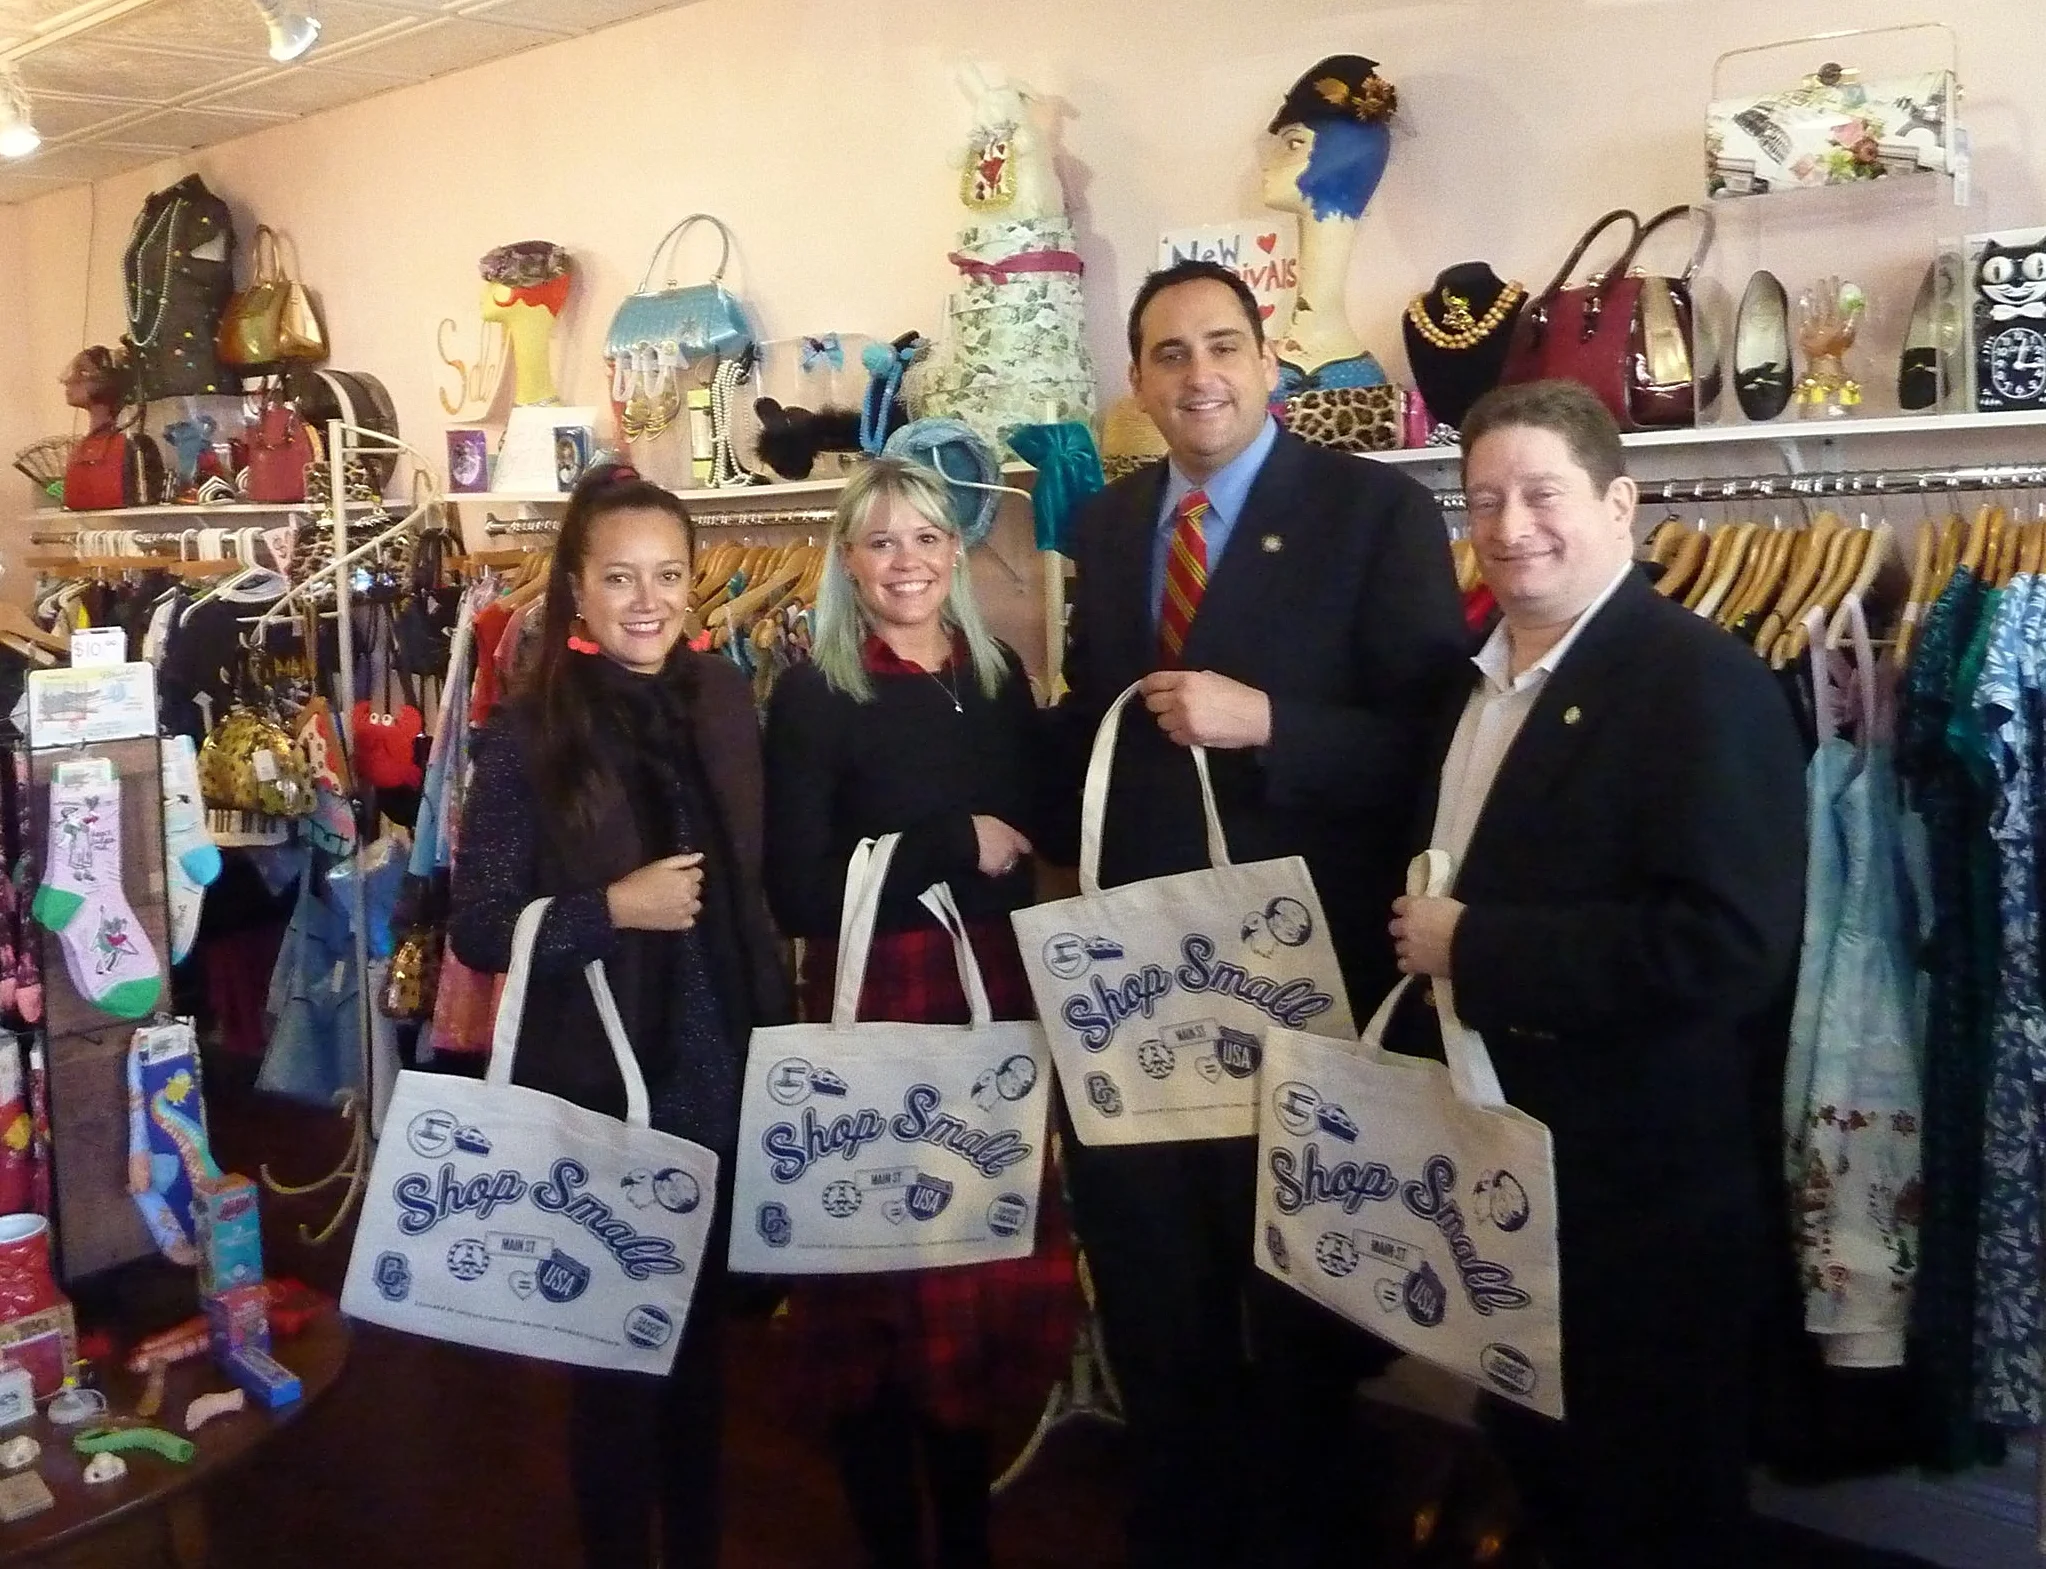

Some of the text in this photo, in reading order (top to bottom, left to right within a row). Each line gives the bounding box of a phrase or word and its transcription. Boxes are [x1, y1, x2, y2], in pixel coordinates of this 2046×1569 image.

[1061, 933, 1334, 1053] Shop Small
[1222, 1040, 1253, 1069] USA
[761, 1084, 1032, 1184] Shop Small
[871, 1173, 891, 1185] MAIN
[912, 1187, 941, 1213] USA
[393, 1157, 685, 1280] Shop Small
[1268, 1143, 1400, 1215] Shop
[1401, 1155, 1532, 1316] Small
[501, 1237, 523, 1251] MAIN
[542, 1263, 575, 1296] USA
[1409, 1279, 1437, 1319] USA
